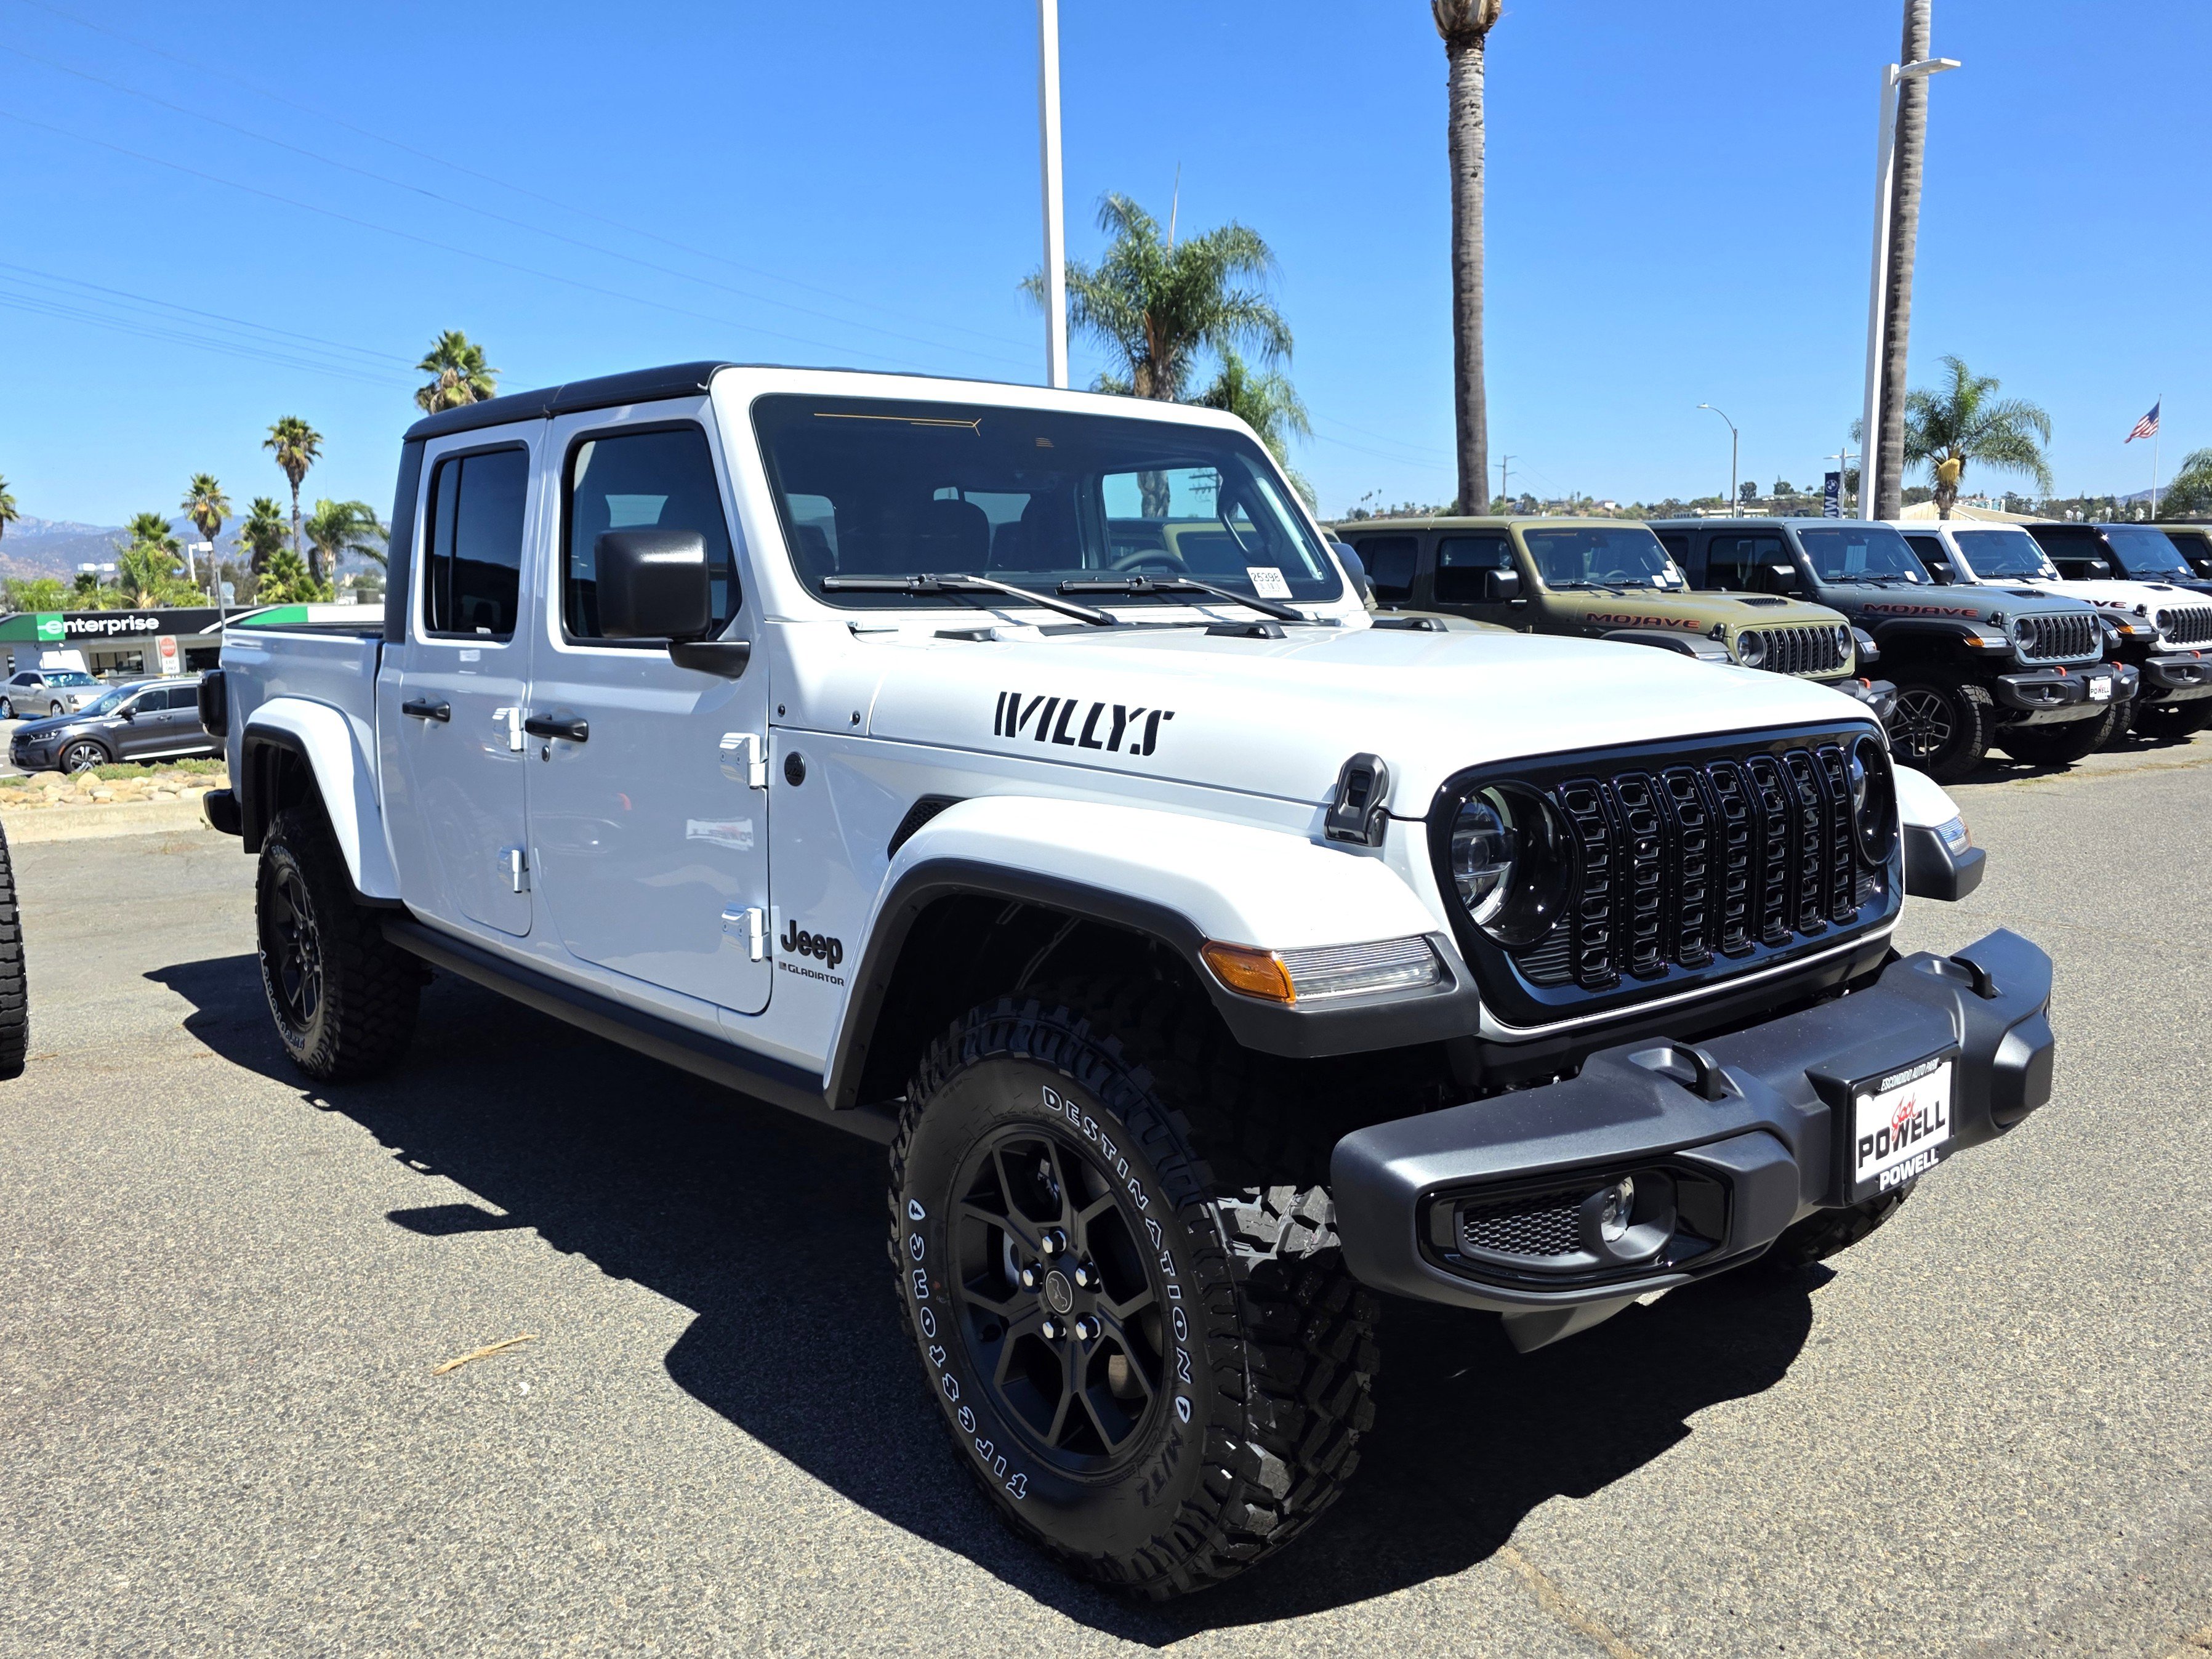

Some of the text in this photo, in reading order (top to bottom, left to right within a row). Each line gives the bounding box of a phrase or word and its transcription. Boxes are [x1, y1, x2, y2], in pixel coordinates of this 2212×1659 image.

[1251, 573, 1281, 582] 25398
[1586, 612, 1702, 629] MOJAVE
[1863, 603, 1979, 617] MOJAVE
[38, 615, 159, 636] enterprise
[2090, 687, 2110, 695] POWELL
[994, 691, 1176, 756] WILLYS
[780, 919, 843, 970] Jeep
[788, 964, 845, 987] GLADIATOR
[1881, 1068, 1913, 1092] ESCONDIDO
[1912, 1063, 1926, 1080] AUTO
[1891, 1092, 1919, 1142] Jack
[1857, 1100, 1946, 1169] POWELL
[1880, 1148, 1939, 1191] POWELL
[1042, 1084, 1192, 1385] DESTINATION
